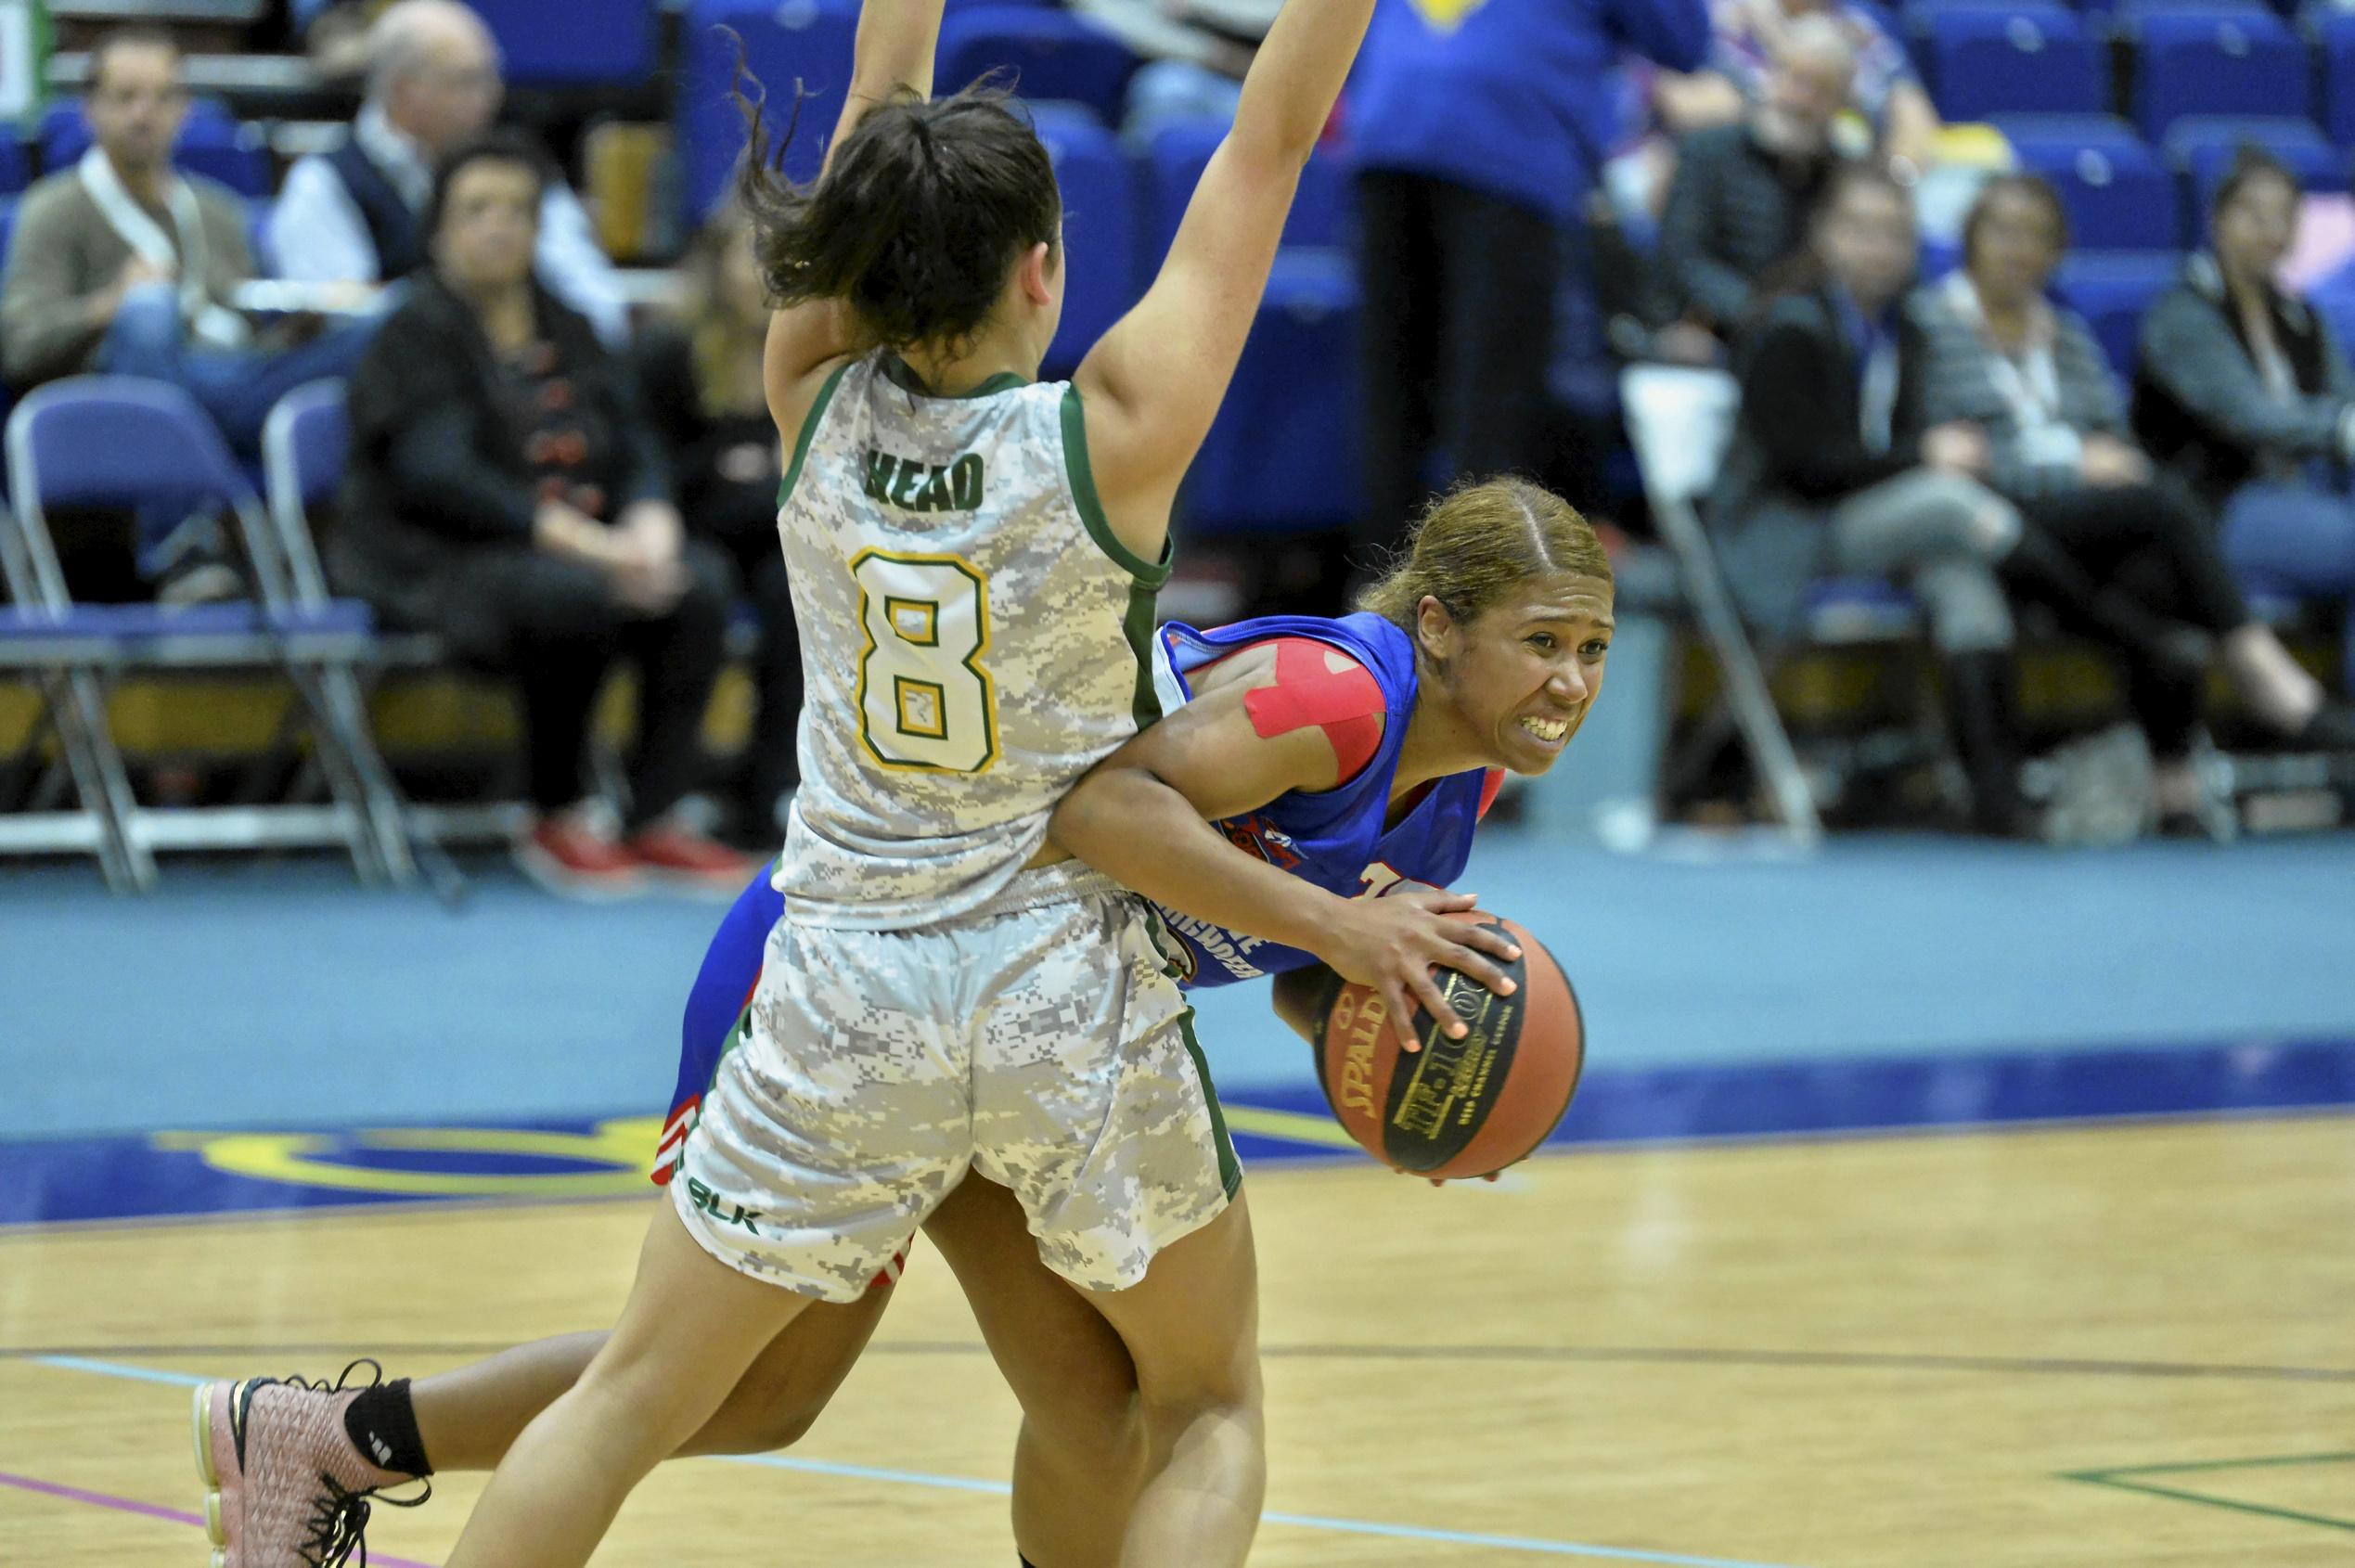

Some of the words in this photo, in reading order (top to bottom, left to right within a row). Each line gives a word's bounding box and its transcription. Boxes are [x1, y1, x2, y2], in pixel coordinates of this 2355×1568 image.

[865, 449, 984, 512] HEAD
[848, 546, 1002, 774] 8
[1341, 987, 1390, 1119] SPALD
[688, 1176, 764, 1236] BLK
